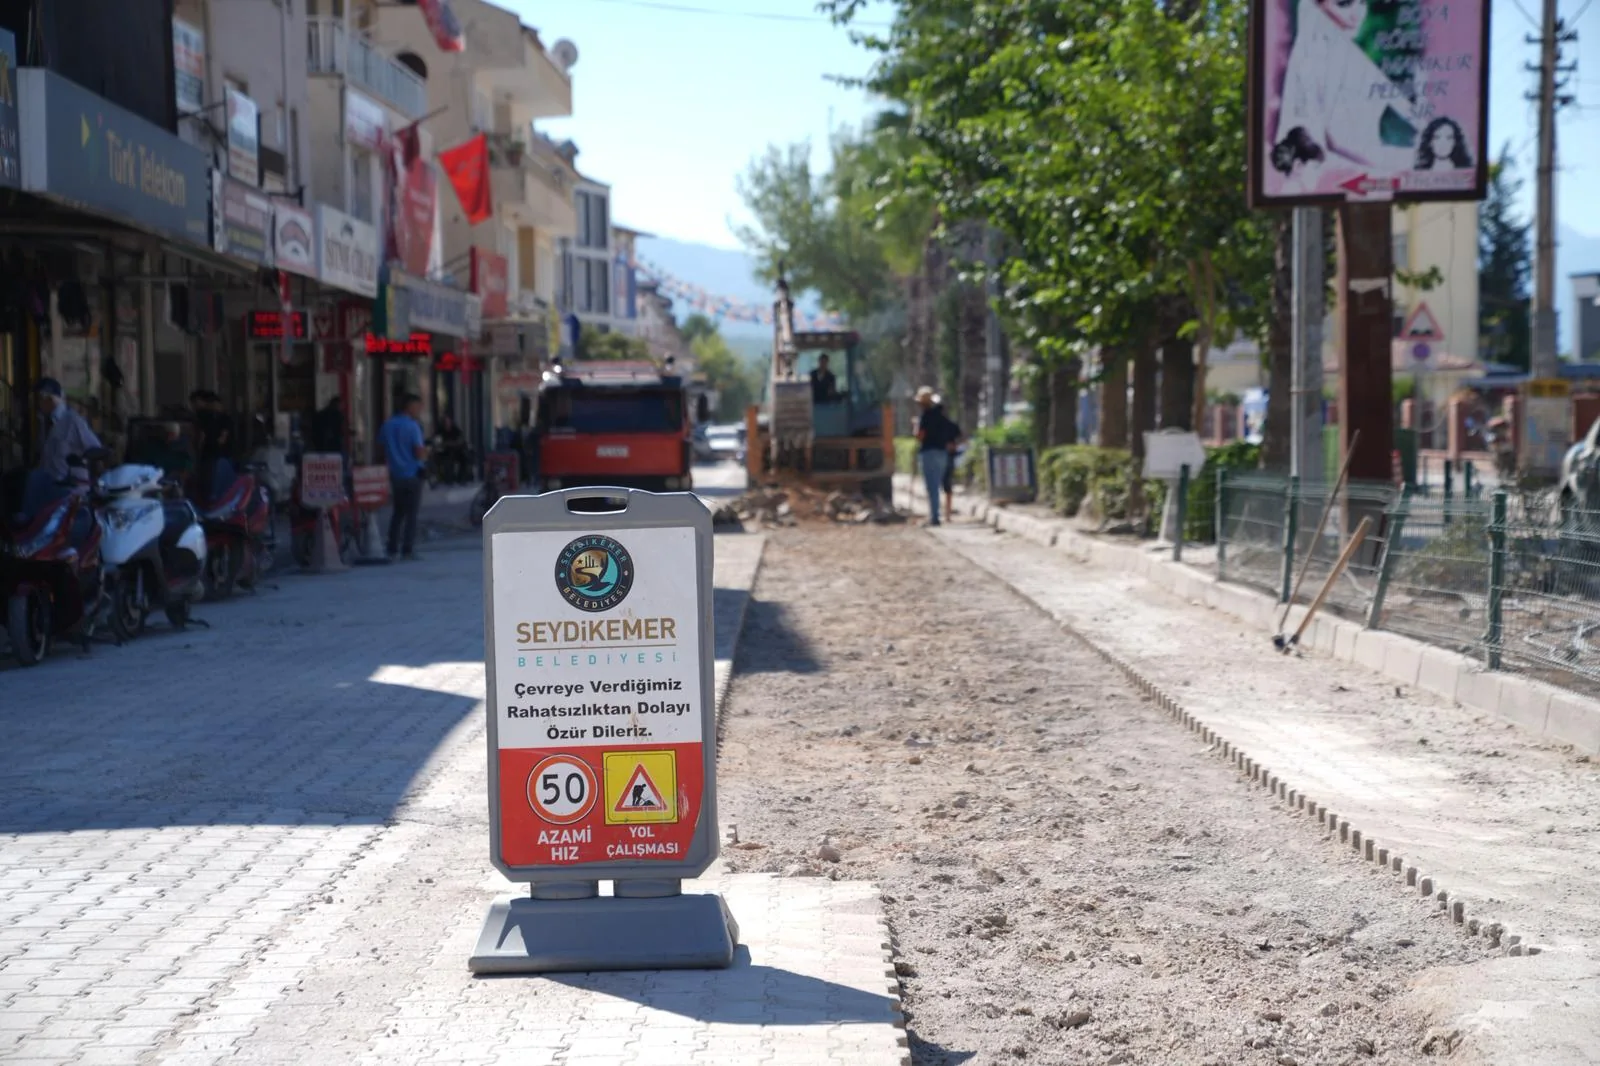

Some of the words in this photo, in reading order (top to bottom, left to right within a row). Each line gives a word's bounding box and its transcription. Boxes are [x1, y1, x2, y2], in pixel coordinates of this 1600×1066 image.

[106, 129, 136, 187] Türk
[139, 147, 186, 207] Telekom
[517, 651, 677, 668] BELEDİYESİ
[514, 682, 585, 699] Çevreye
[589, 678, 682, 695] Verdiğimiz
[507, 702, 632, 719] Rahatsızlıktan
[637, 701, 691, 716] Dolayı
[546, 724, 588, 740] Özür
[592, 724, 653, 739] Dileriz.
[542, 772, 586, 805] 50
[536, 825, 592, 846] AZAMİ
[628, 826, 656, 838] YOL
[551, 846, 580, 861] HIZ
[606, 842, 679, 858] ÇALIŞMASI
